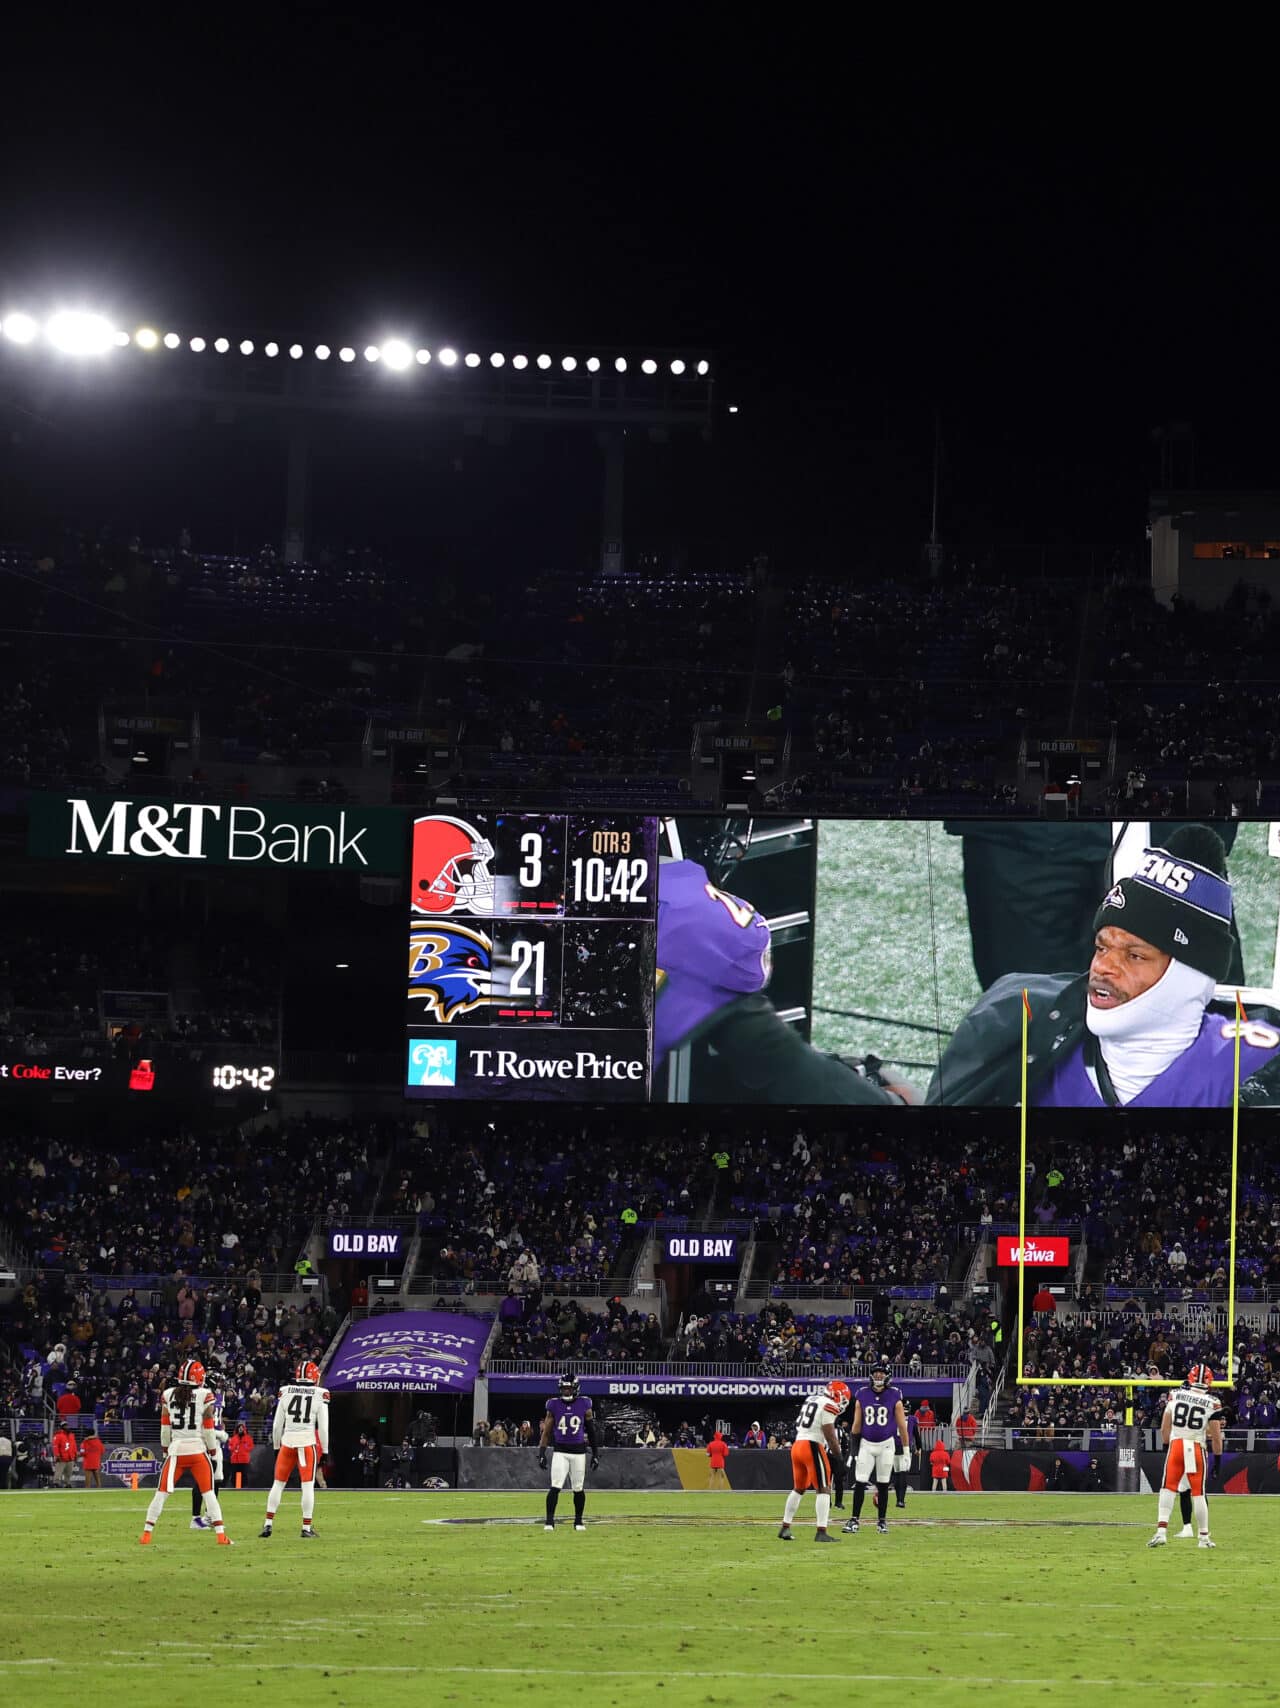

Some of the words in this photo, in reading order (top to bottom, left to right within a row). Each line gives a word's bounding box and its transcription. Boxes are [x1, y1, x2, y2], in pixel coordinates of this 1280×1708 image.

[65, 799, 221, 859] M&T
[228, 806, 368, 865] Bank
[591, 831, 620, 854] QTR
[621, 831, 631, 854] 3
[519, 832, 542, 888] 3
[572, 858, 649, 903] 10:42
[510, 941, 546, 996] 21
[12, 1063, 52, 1080] Coke
[54, 1066, 102, 1081] Ever?
[212, 1064, 276, 1091] 10:42
[333, 1234, 364, 1253] OLD
[367, 1235, 398, 1253] BAY
[669, 1239, 700, 1257] OLD
[703, 1239, 733, 1257] BAY
[1010, 1247, 1055, 1263] Wawa
[352, 1330, 475, 1345] MEDSTAR
[361, 1336, 463, 1348] HEALTH
[336, 1362, 464, 1378] MEDSTAR
[346, 1368, 451, 1383] HEALTH
[356, 1381, 401, 1391] MEDSTAR
[402, 1382, 437, 1391] HEALTH
[609, 1383, 640, 1396] BUD
[643, 1382, 688, 1396] LIGHT
[690, 1383, 787, 1397] TOUCHDOWN
[788, 1383, 827, 1397] CLUB
[170, 1402, 197, 1431] 31
[287, 1395, 314, 1424] 41
[865, 1406, 888, 1426] 88
[1172, 1402, 1207, 1430] 86
[558, 1415, 581, 1436] 49
